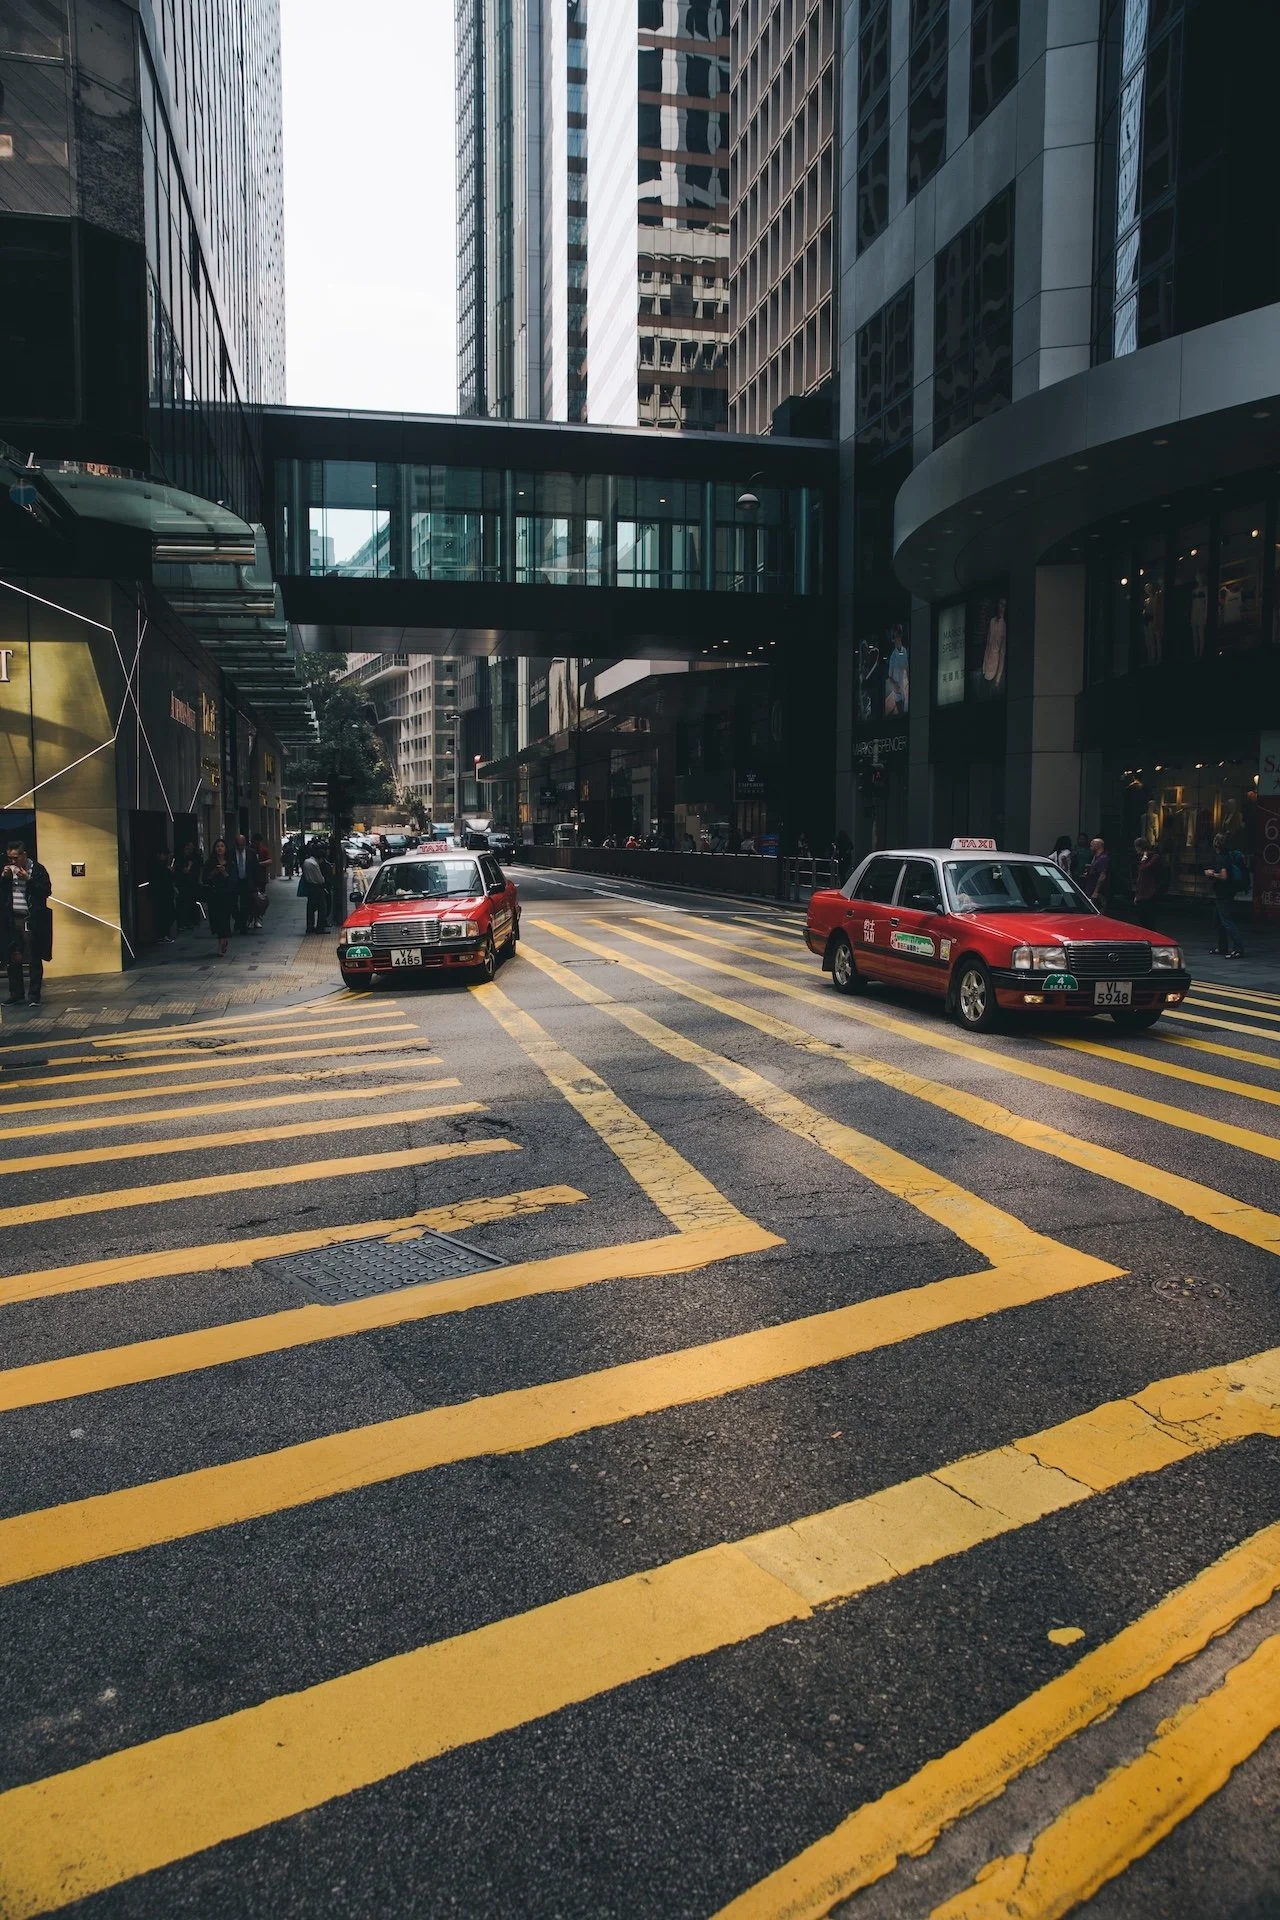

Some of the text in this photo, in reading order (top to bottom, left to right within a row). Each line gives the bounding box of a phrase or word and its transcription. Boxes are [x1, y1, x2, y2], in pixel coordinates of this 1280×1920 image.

[419, 844, 448, 852] TAXI
[959, 839, 993, 848] TAXI
[863, 918, 875, 931] 的士
[863, 930, 875, 943] TAXI
[400, 949, 412, 958] VZ
[394, 957, 420, 966] 4485
[1057, 976, 1065, 985] 4
[1106, 982, 1121, 993] VL
[1097, 993, 1129, 1004] 5948
